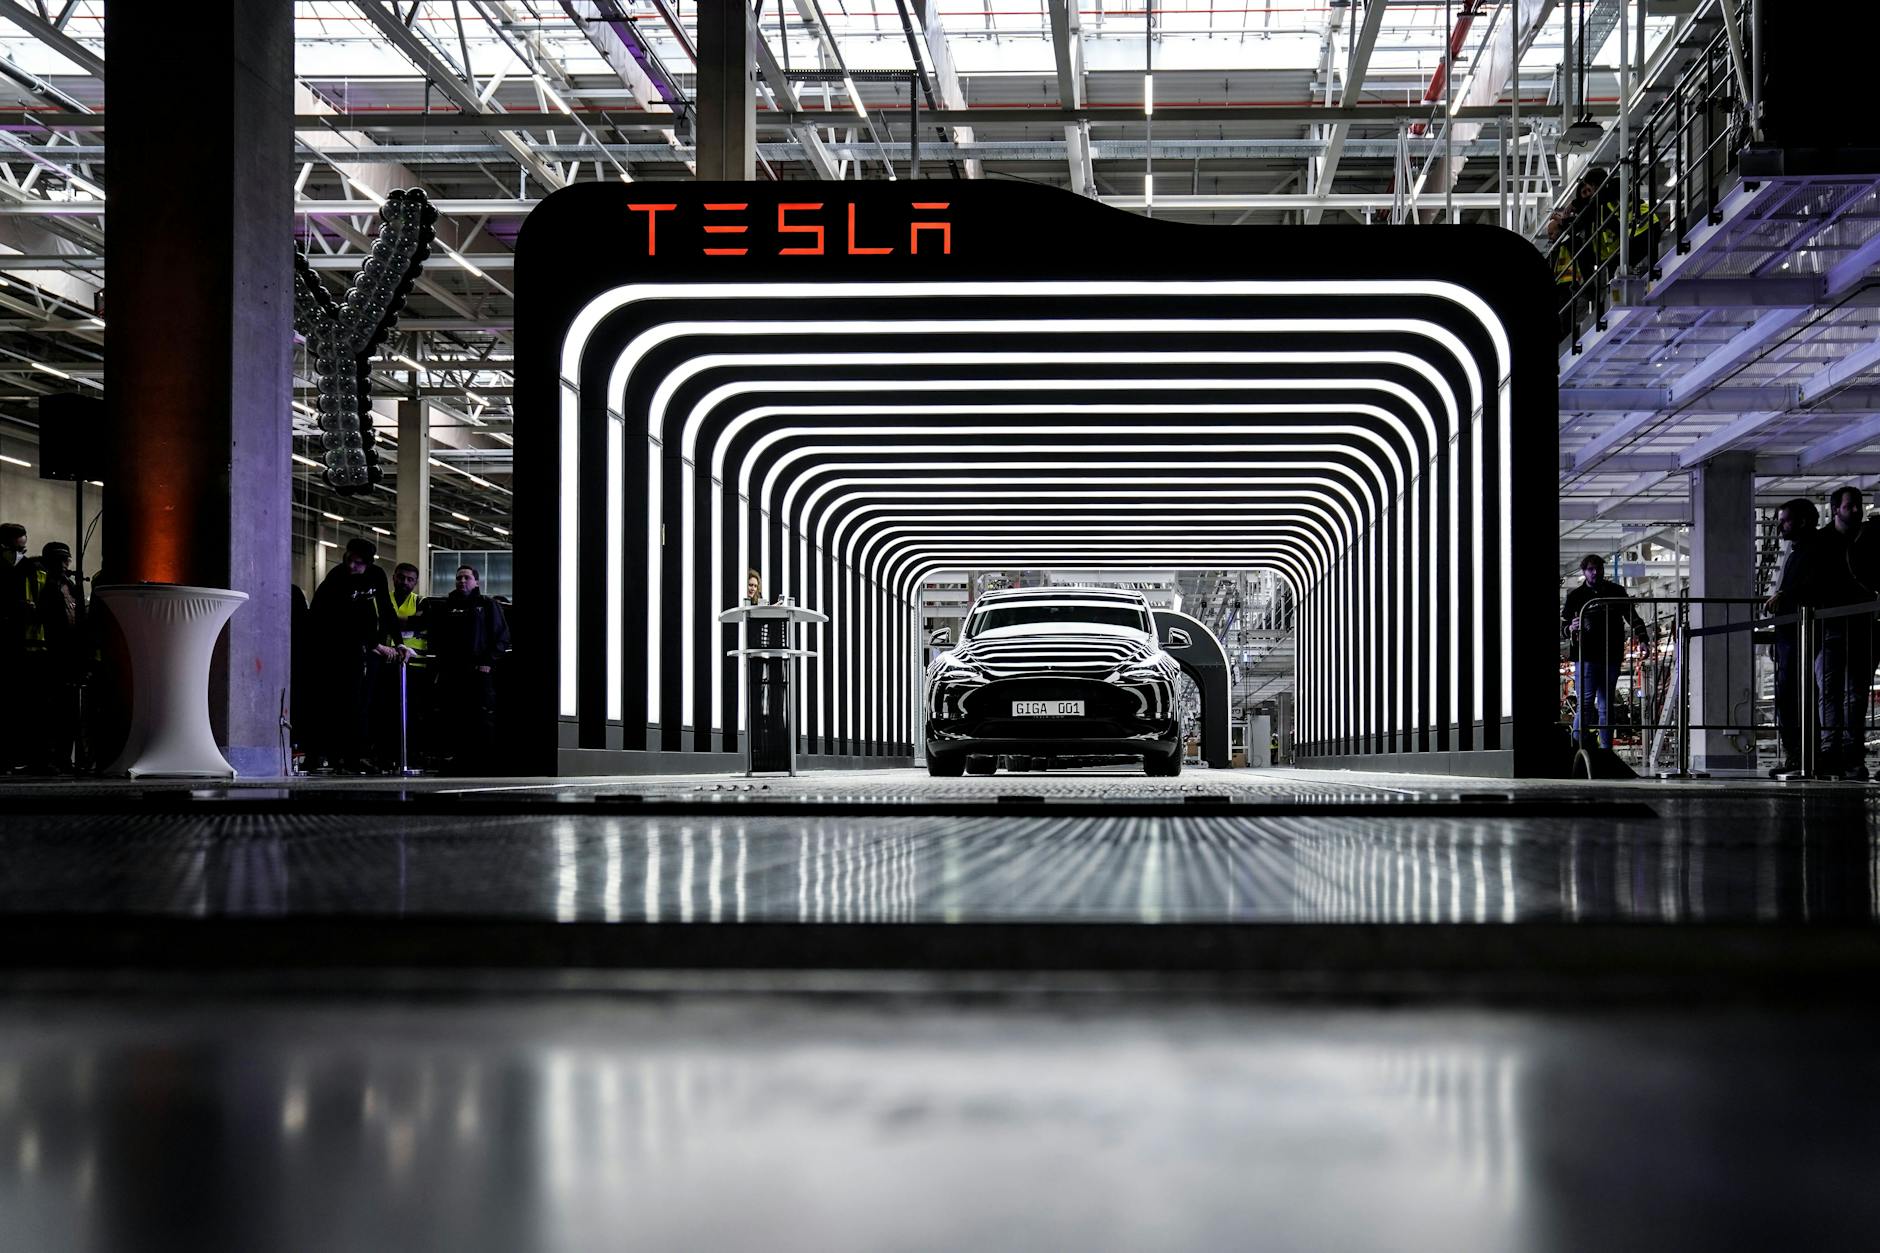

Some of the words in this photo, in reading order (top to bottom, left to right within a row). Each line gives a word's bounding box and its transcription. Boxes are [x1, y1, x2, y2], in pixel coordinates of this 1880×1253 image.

[627, 202, 950, 255] TESLA
[1016, 702, 1047, 714] GIGA
[1058, 702, 1080, 714] 001
